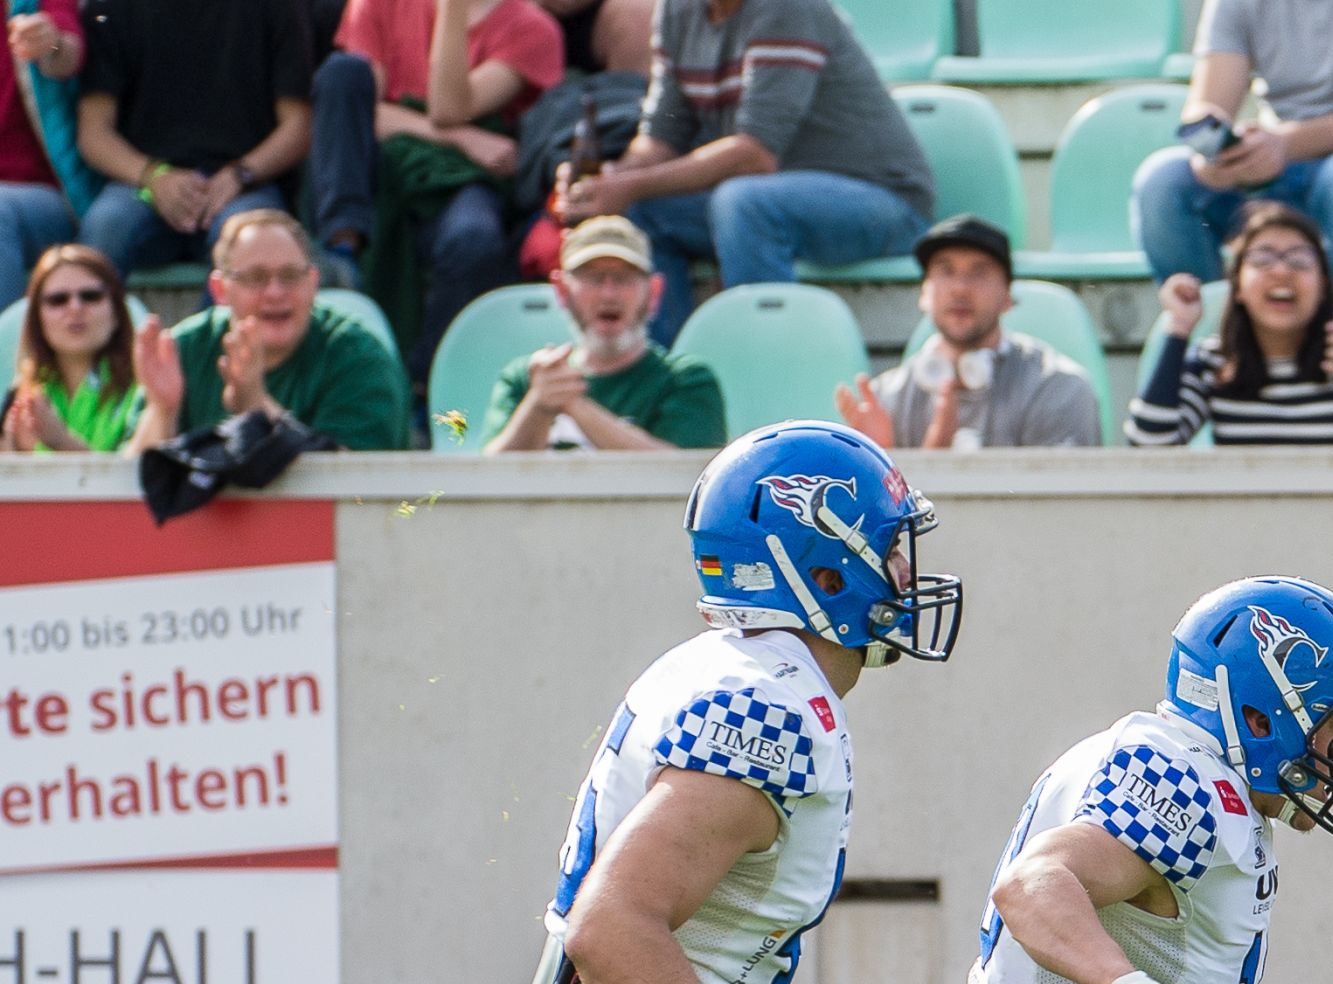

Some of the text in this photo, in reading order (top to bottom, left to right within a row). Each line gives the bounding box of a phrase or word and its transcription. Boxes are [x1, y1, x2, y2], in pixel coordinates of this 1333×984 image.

[82, 616, 130, 649] bis
[141, 607, 230, 644] 23:00
[241, 603, 303, 635] Uhr
[3, 666, 320, 736] te sichern
[710, 721, 786, 765] TIMES
[1, 752, 289, 826] erhalten!
[1127, 773, 1193, 832] TIMES
